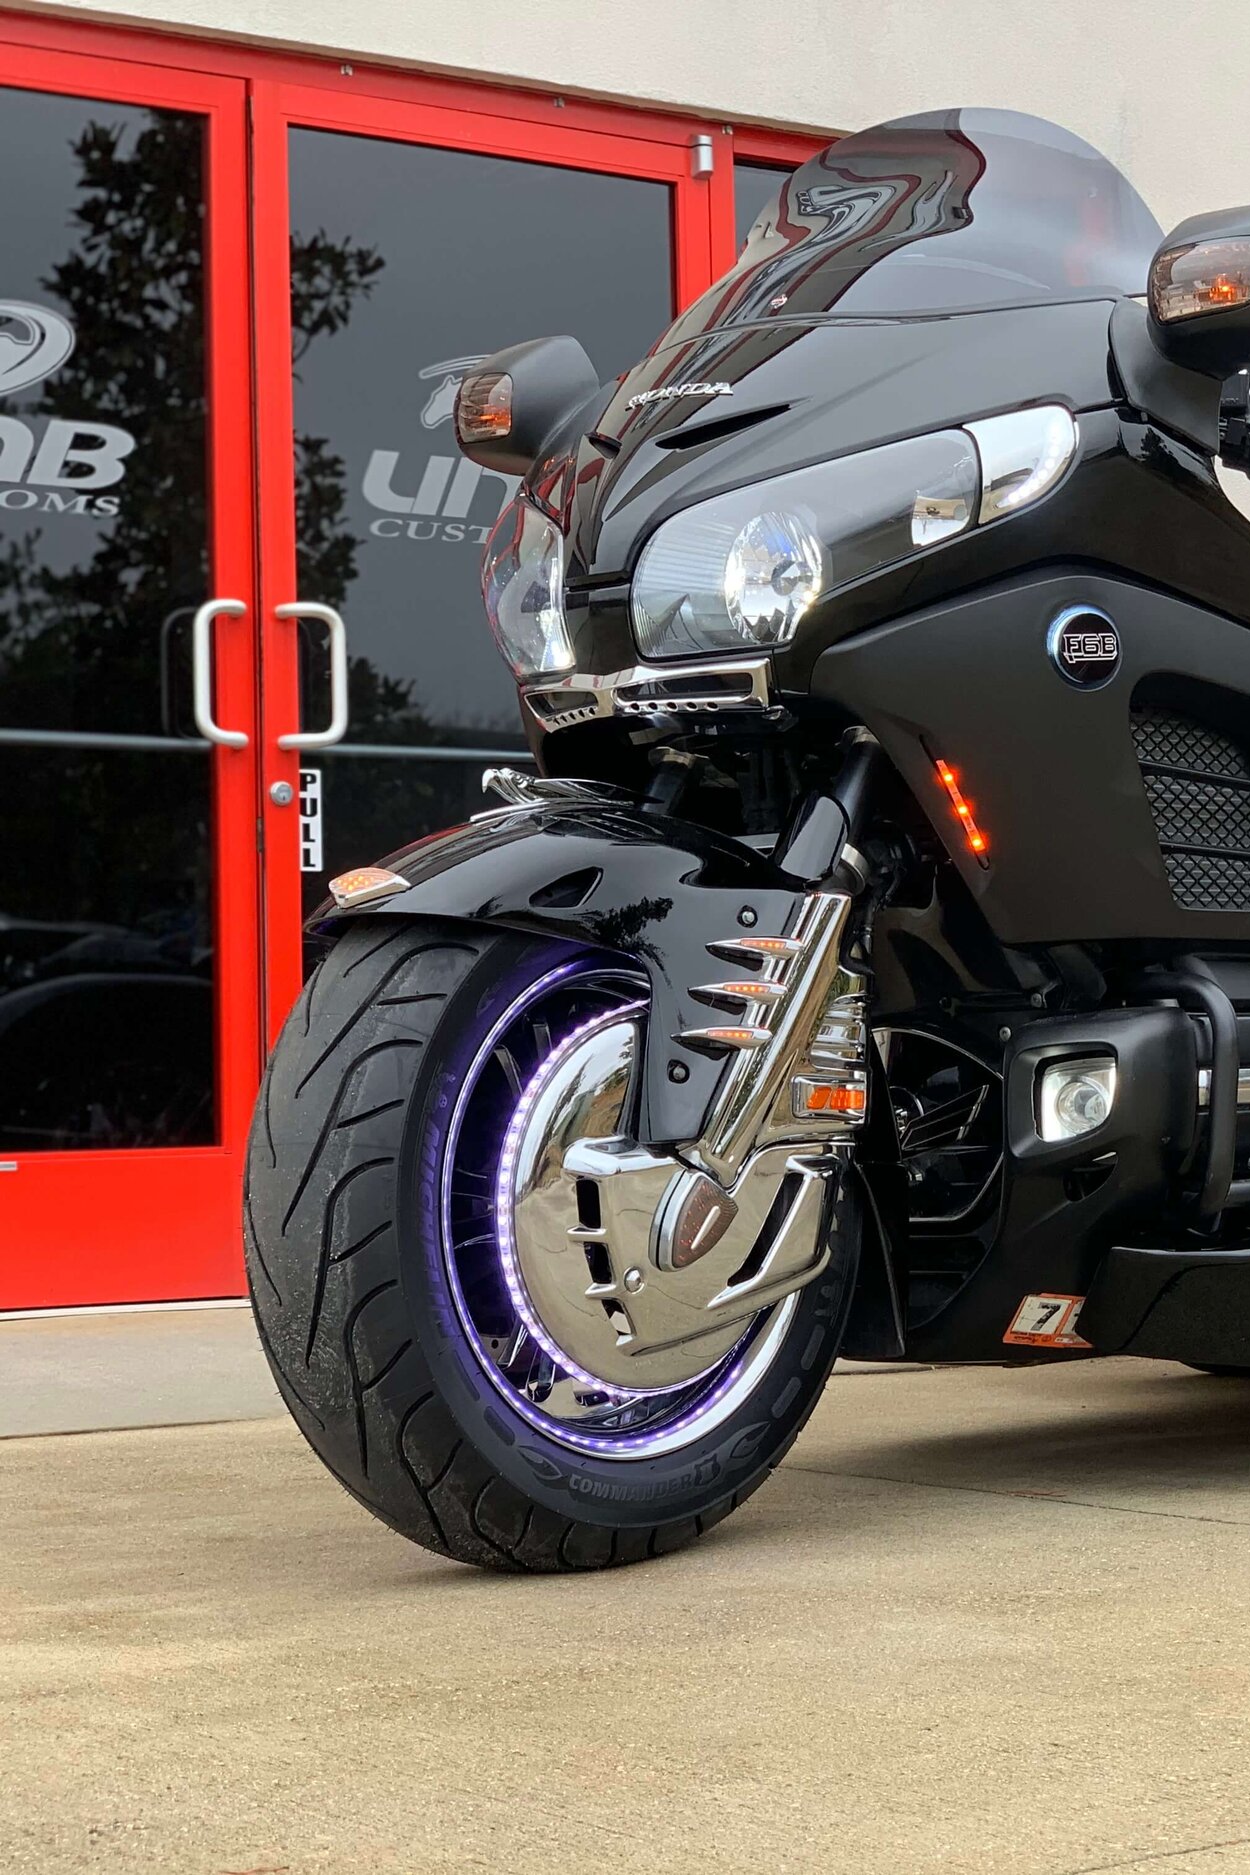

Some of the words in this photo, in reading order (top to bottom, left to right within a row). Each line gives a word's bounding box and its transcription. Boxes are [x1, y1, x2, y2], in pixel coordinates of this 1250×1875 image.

[1062, 633, 1118, 661] F6B
[299, 773, 318, 867] PULL
[1031, 1302, 1061, 1331] 7
[568, 1472, 695, 1502] COMMANDER
